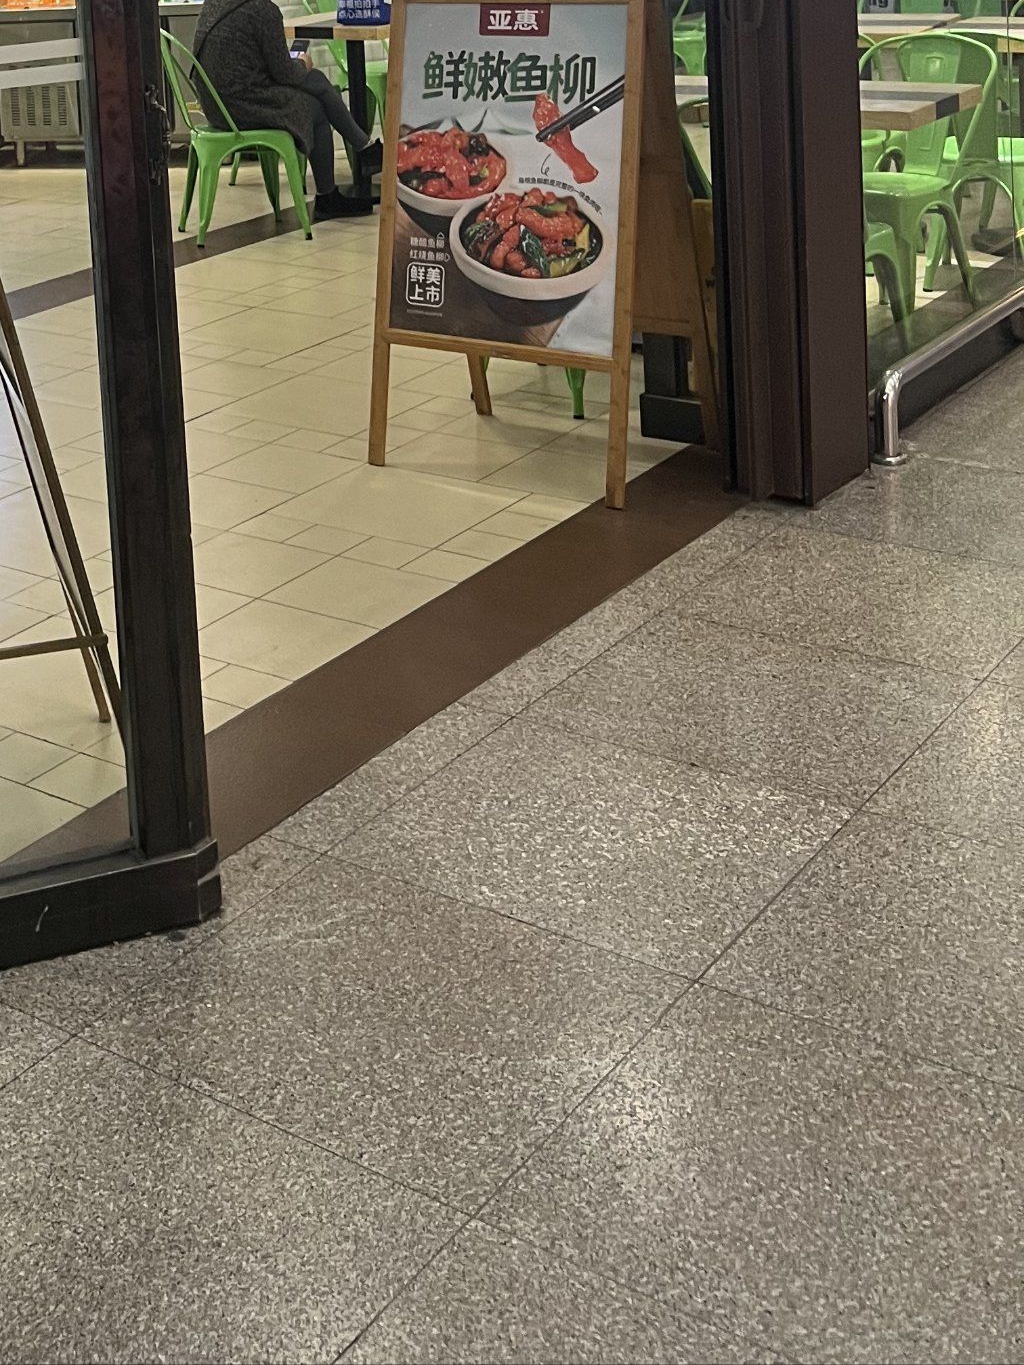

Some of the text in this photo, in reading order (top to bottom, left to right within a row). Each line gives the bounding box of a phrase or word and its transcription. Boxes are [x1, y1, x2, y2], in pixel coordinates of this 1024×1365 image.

[487, 9, 539, 31] 亚惠
[422, 50, 597, 105] 鲜嫩鱼柳
[410, 265, 441, 285] 鲜美
[409, 283, 441, 303] 上市
